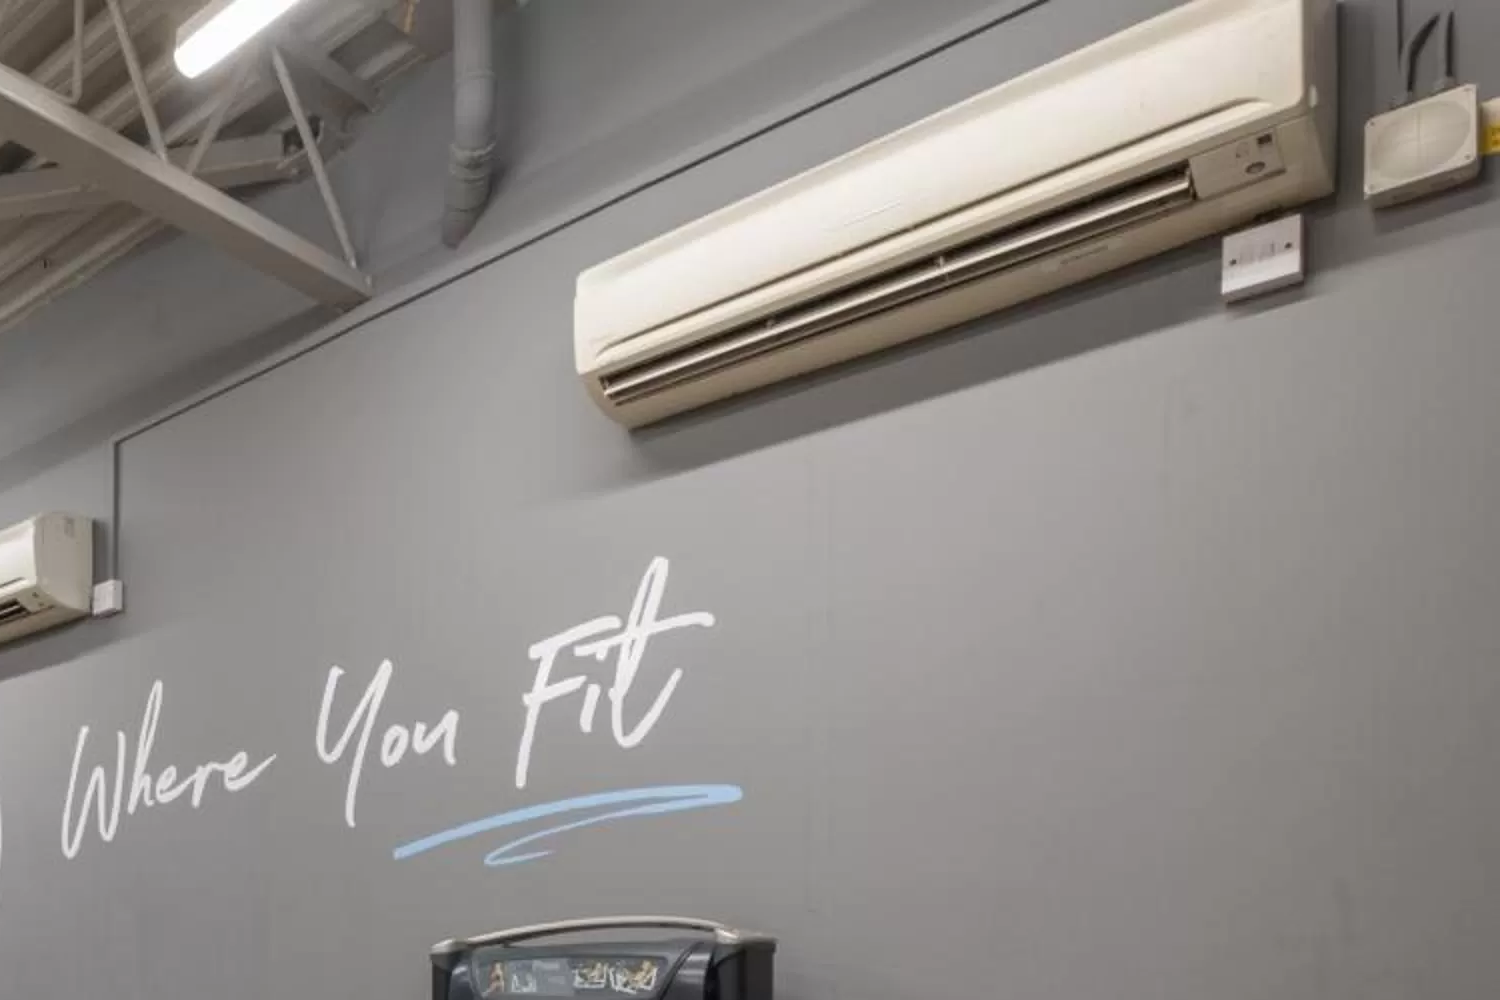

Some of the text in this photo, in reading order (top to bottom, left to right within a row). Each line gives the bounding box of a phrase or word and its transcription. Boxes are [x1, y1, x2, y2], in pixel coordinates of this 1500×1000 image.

[60, 554, 715, 860] Where You Fit
